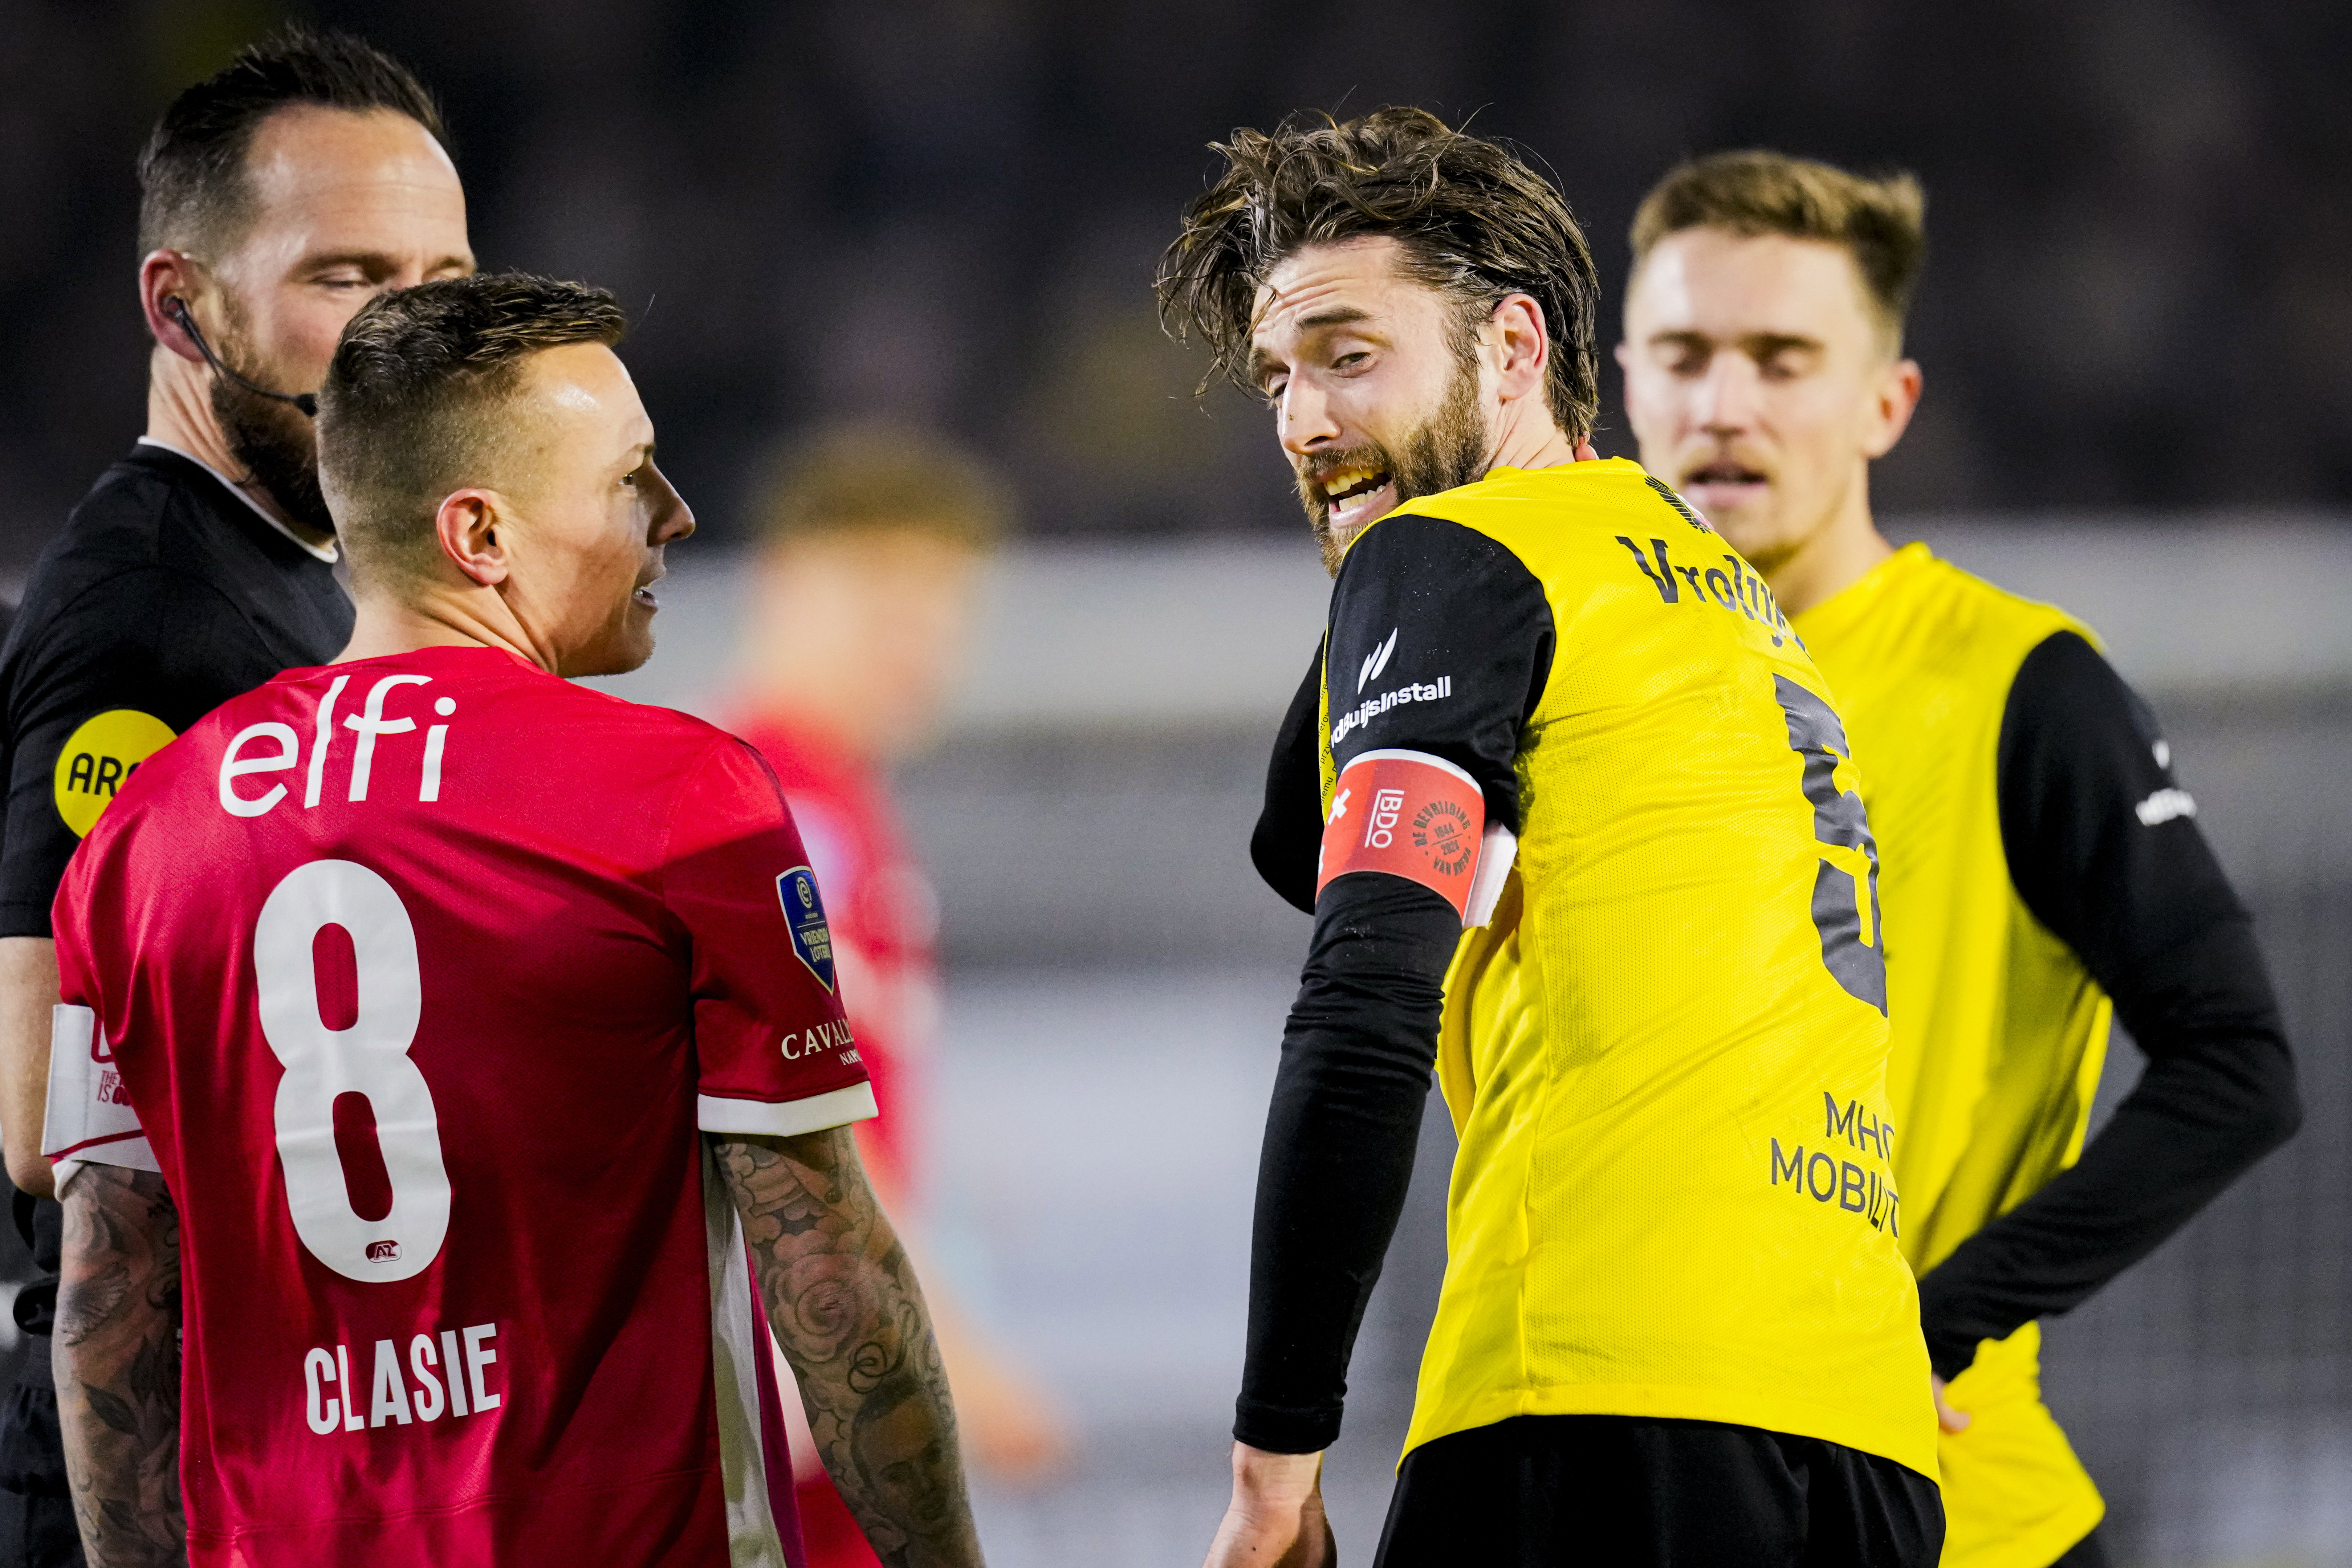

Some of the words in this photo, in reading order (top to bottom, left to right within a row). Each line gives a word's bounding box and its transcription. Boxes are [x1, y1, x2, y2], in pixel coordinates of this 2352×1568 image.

[220, 674, 456, 817] elfi
[254, 859, 452, 1283] 8
[304, 1323, 501, 1435] CLASIE
